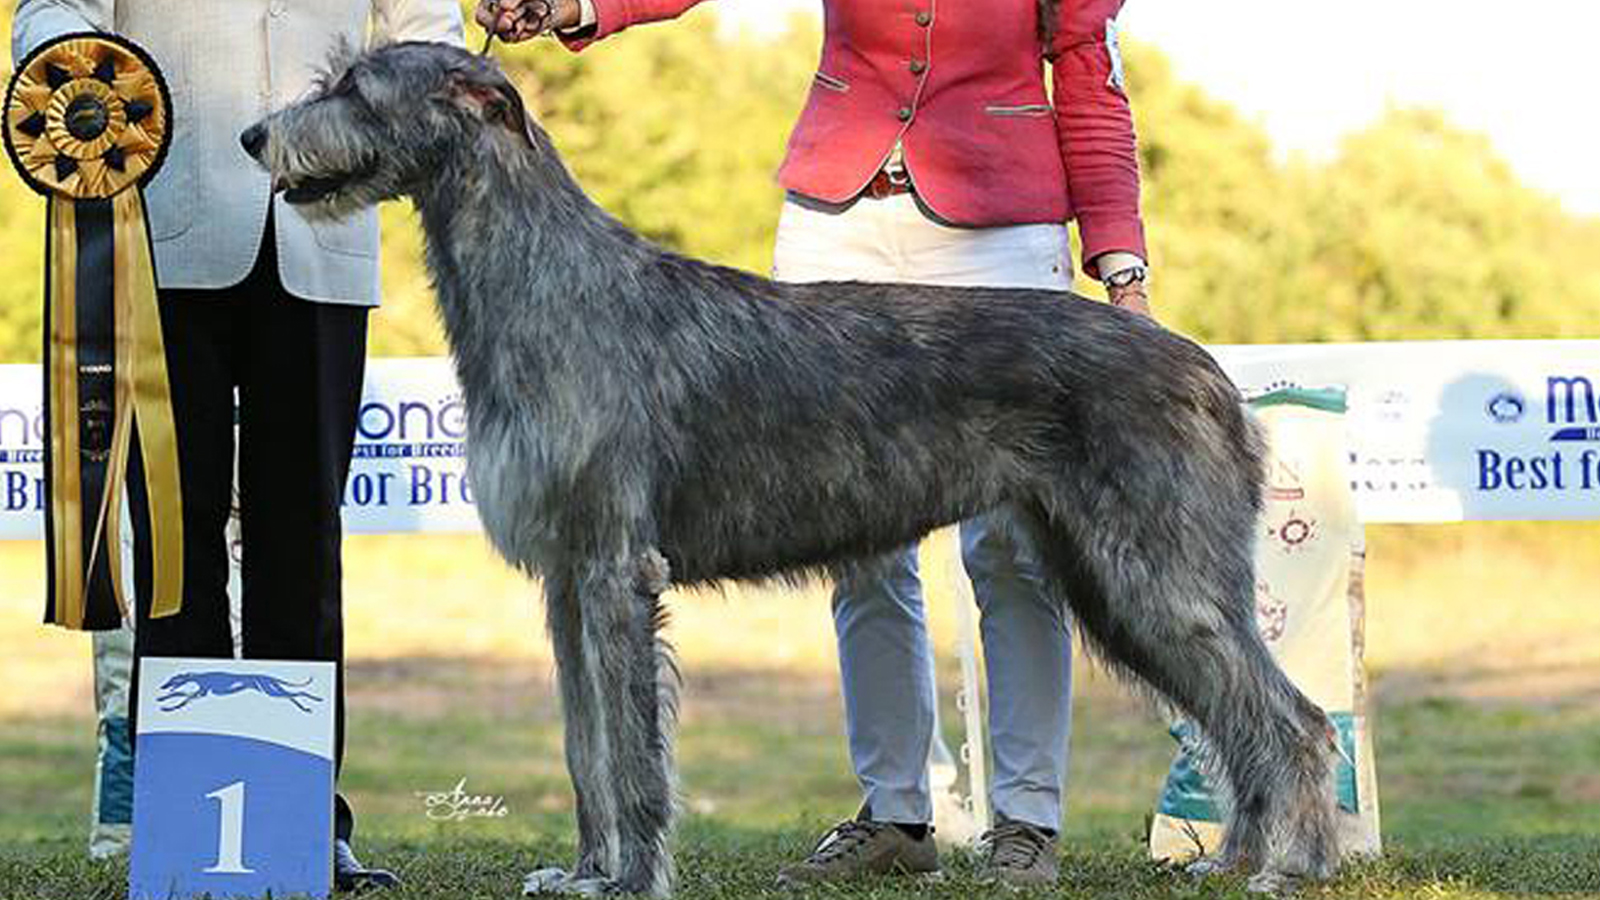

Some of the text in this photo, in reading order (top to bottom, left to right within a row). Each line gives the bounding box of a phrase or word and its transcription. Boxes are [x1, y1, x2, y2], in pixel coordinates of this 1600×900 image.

[1547, 376, 1600, 424] m
[1477, 449, 1600, 490] Best f
[203, 781, 255, 874] 1
